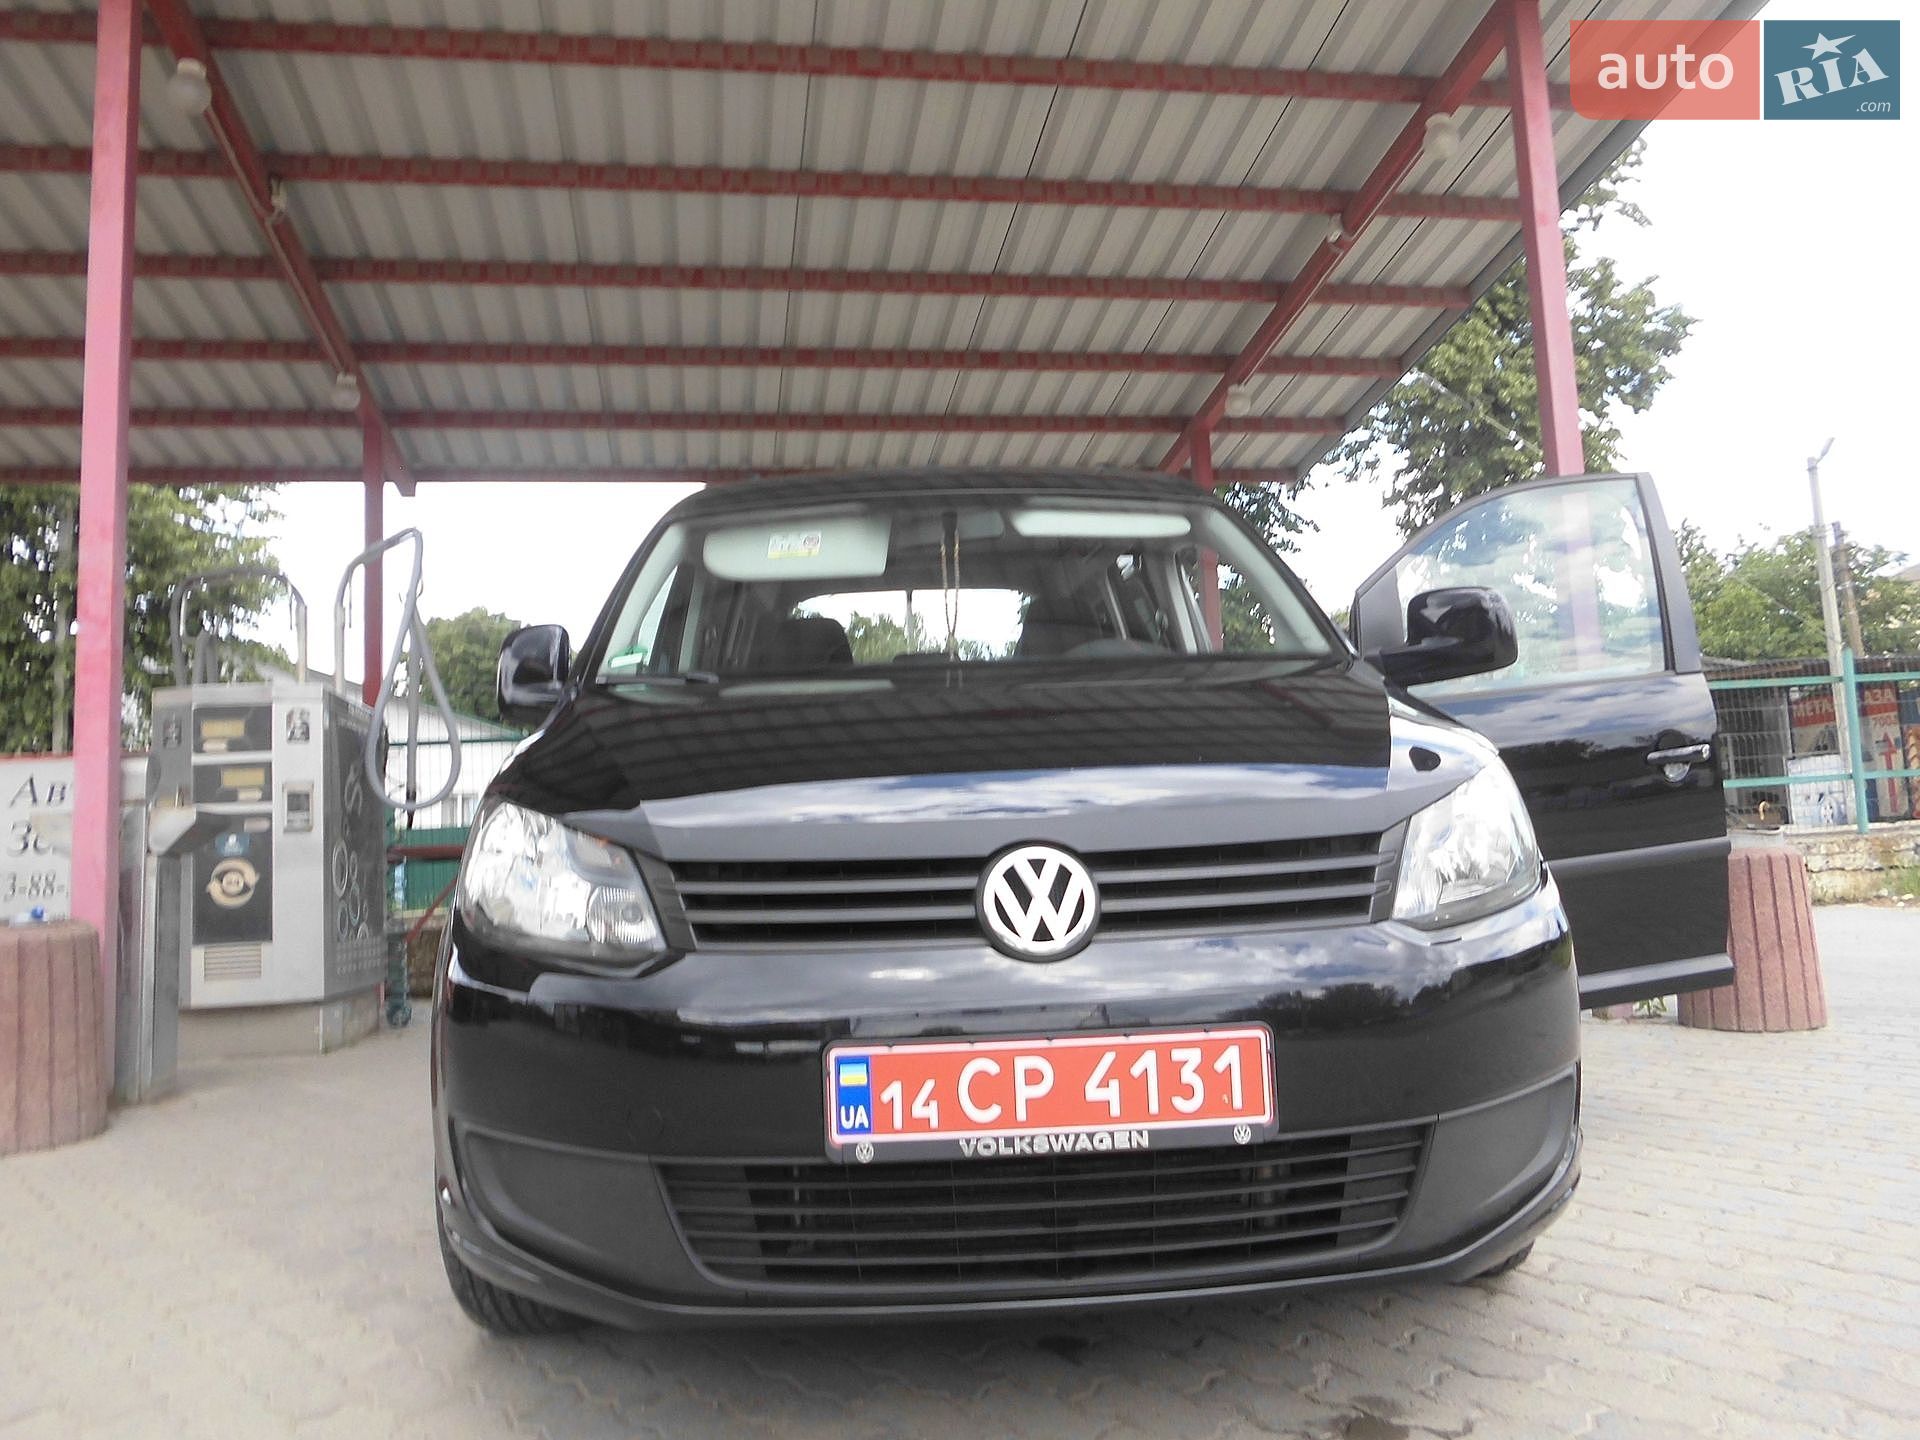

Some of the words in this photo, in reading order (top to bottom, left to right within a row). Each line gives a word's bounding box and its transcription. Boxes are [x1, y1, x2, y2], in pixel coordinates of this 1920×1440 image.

[840, 1105, 869, 1129] UA
[880, 1079, 939, 1130] 14
[957, 1055, 1055, 1124] CP
[1083, 1044, 1243, 1118] 4131
[958, 1129, 1149, 1158] VOLKSWAGEN
